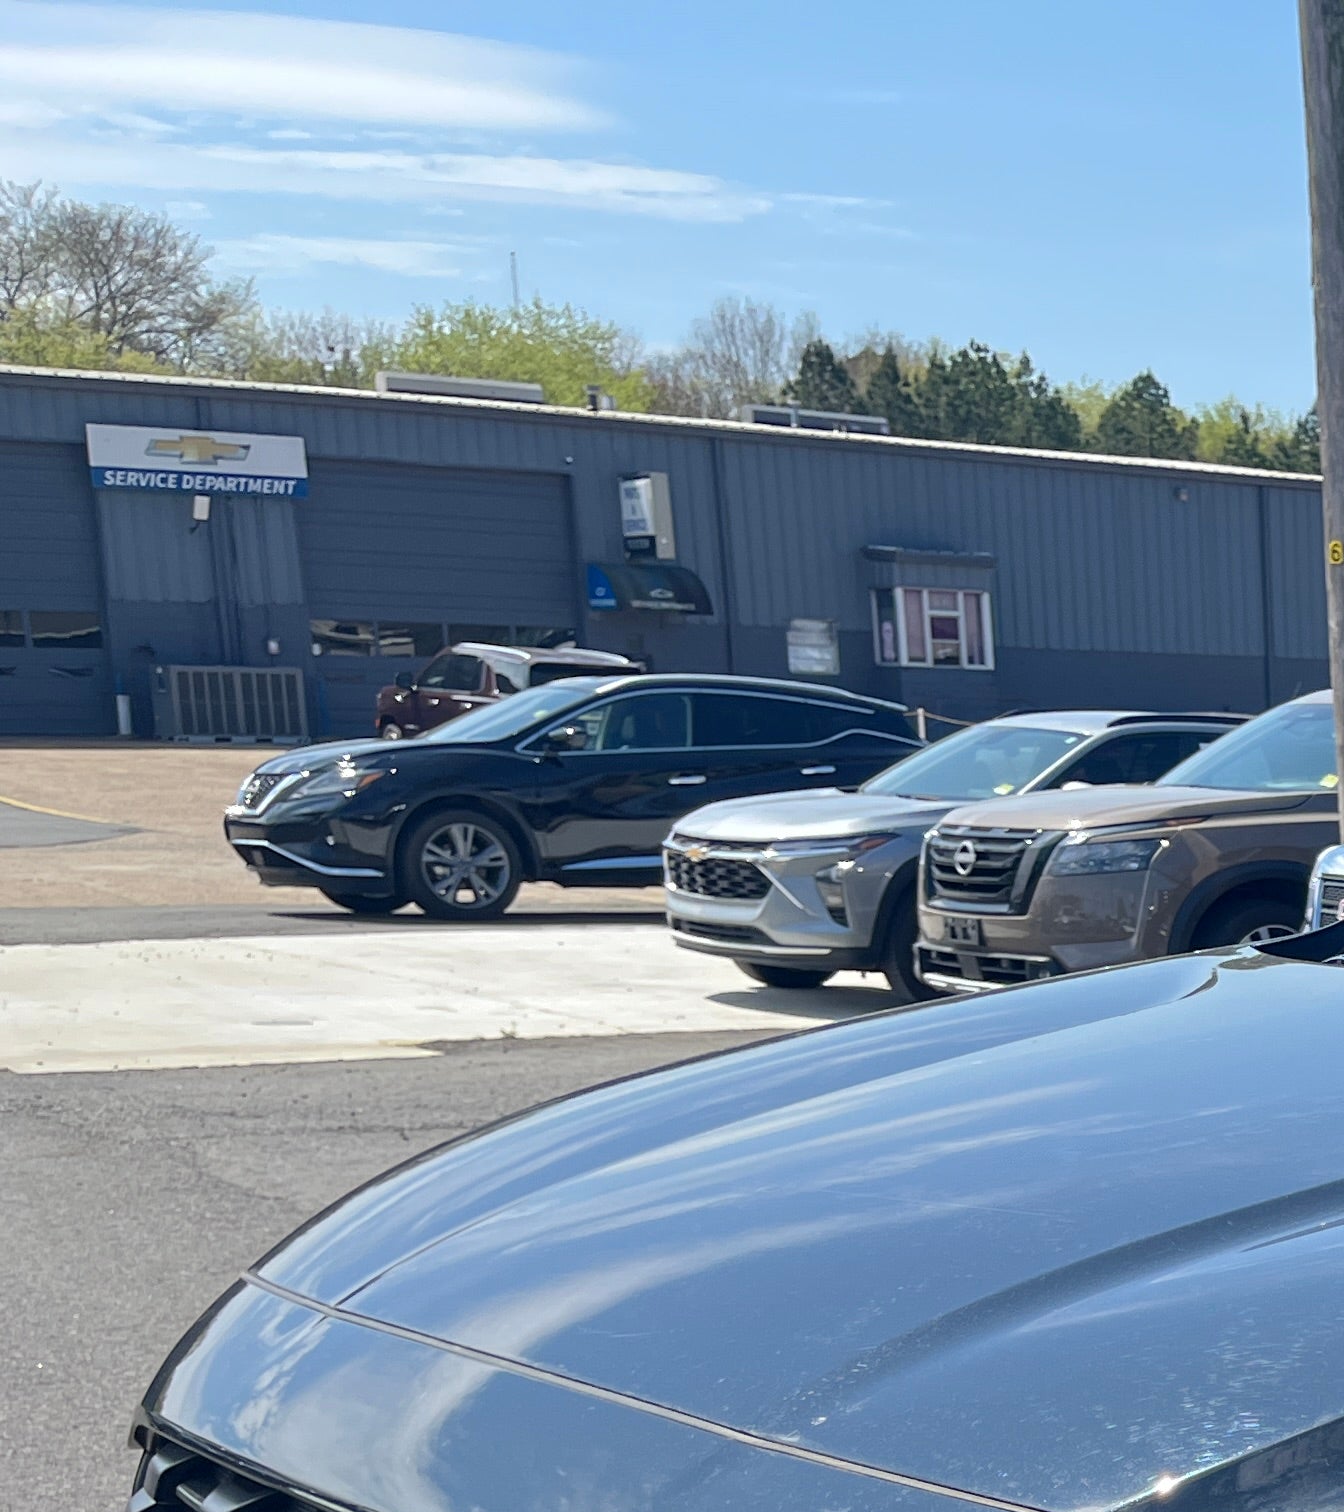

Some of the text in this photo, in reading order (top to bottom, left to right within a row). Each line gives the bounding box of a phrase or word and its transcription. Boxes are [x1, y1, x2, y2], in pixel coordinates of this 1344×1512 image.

[104, 470, 297, 495] SERVICE DEPARTMENT
[1331, 543, 1341, 562] 6
